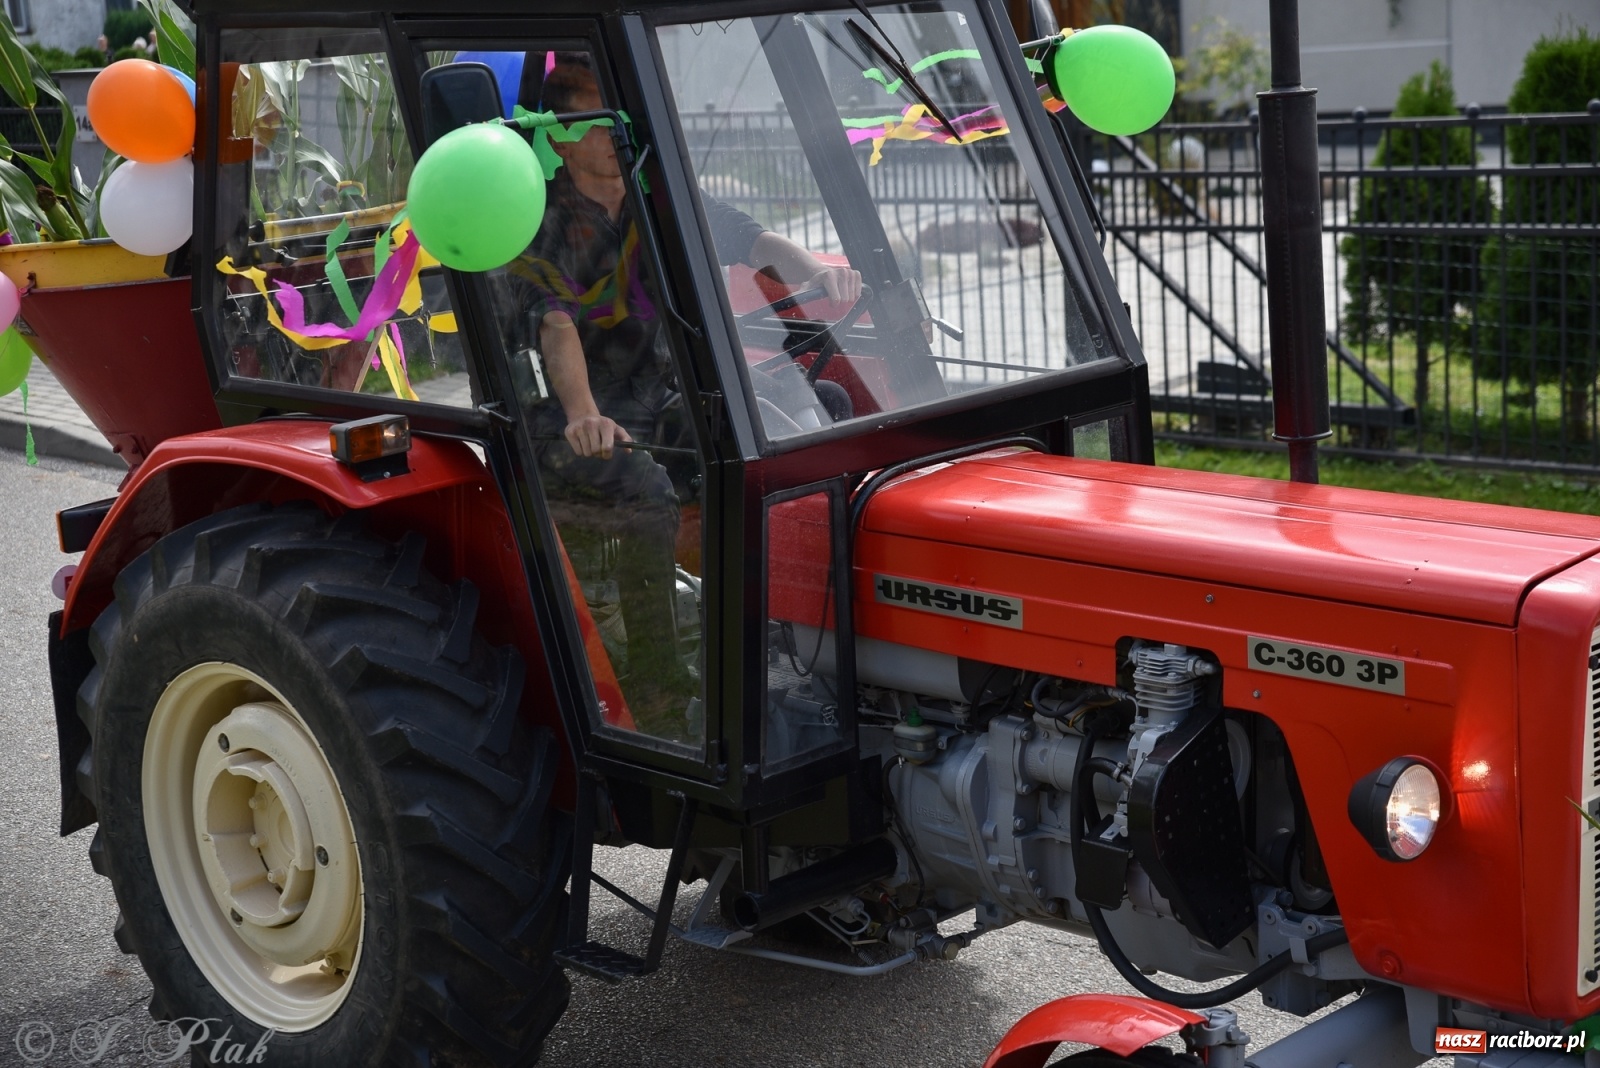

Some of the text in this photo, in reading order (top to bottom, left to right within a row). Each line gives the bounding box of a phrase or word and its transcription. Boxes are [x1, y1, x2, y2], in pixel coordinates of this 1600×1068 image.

[877, 579, 1018, 621] URSUS
[1254, 642, 1399, 685] C-360 3P
